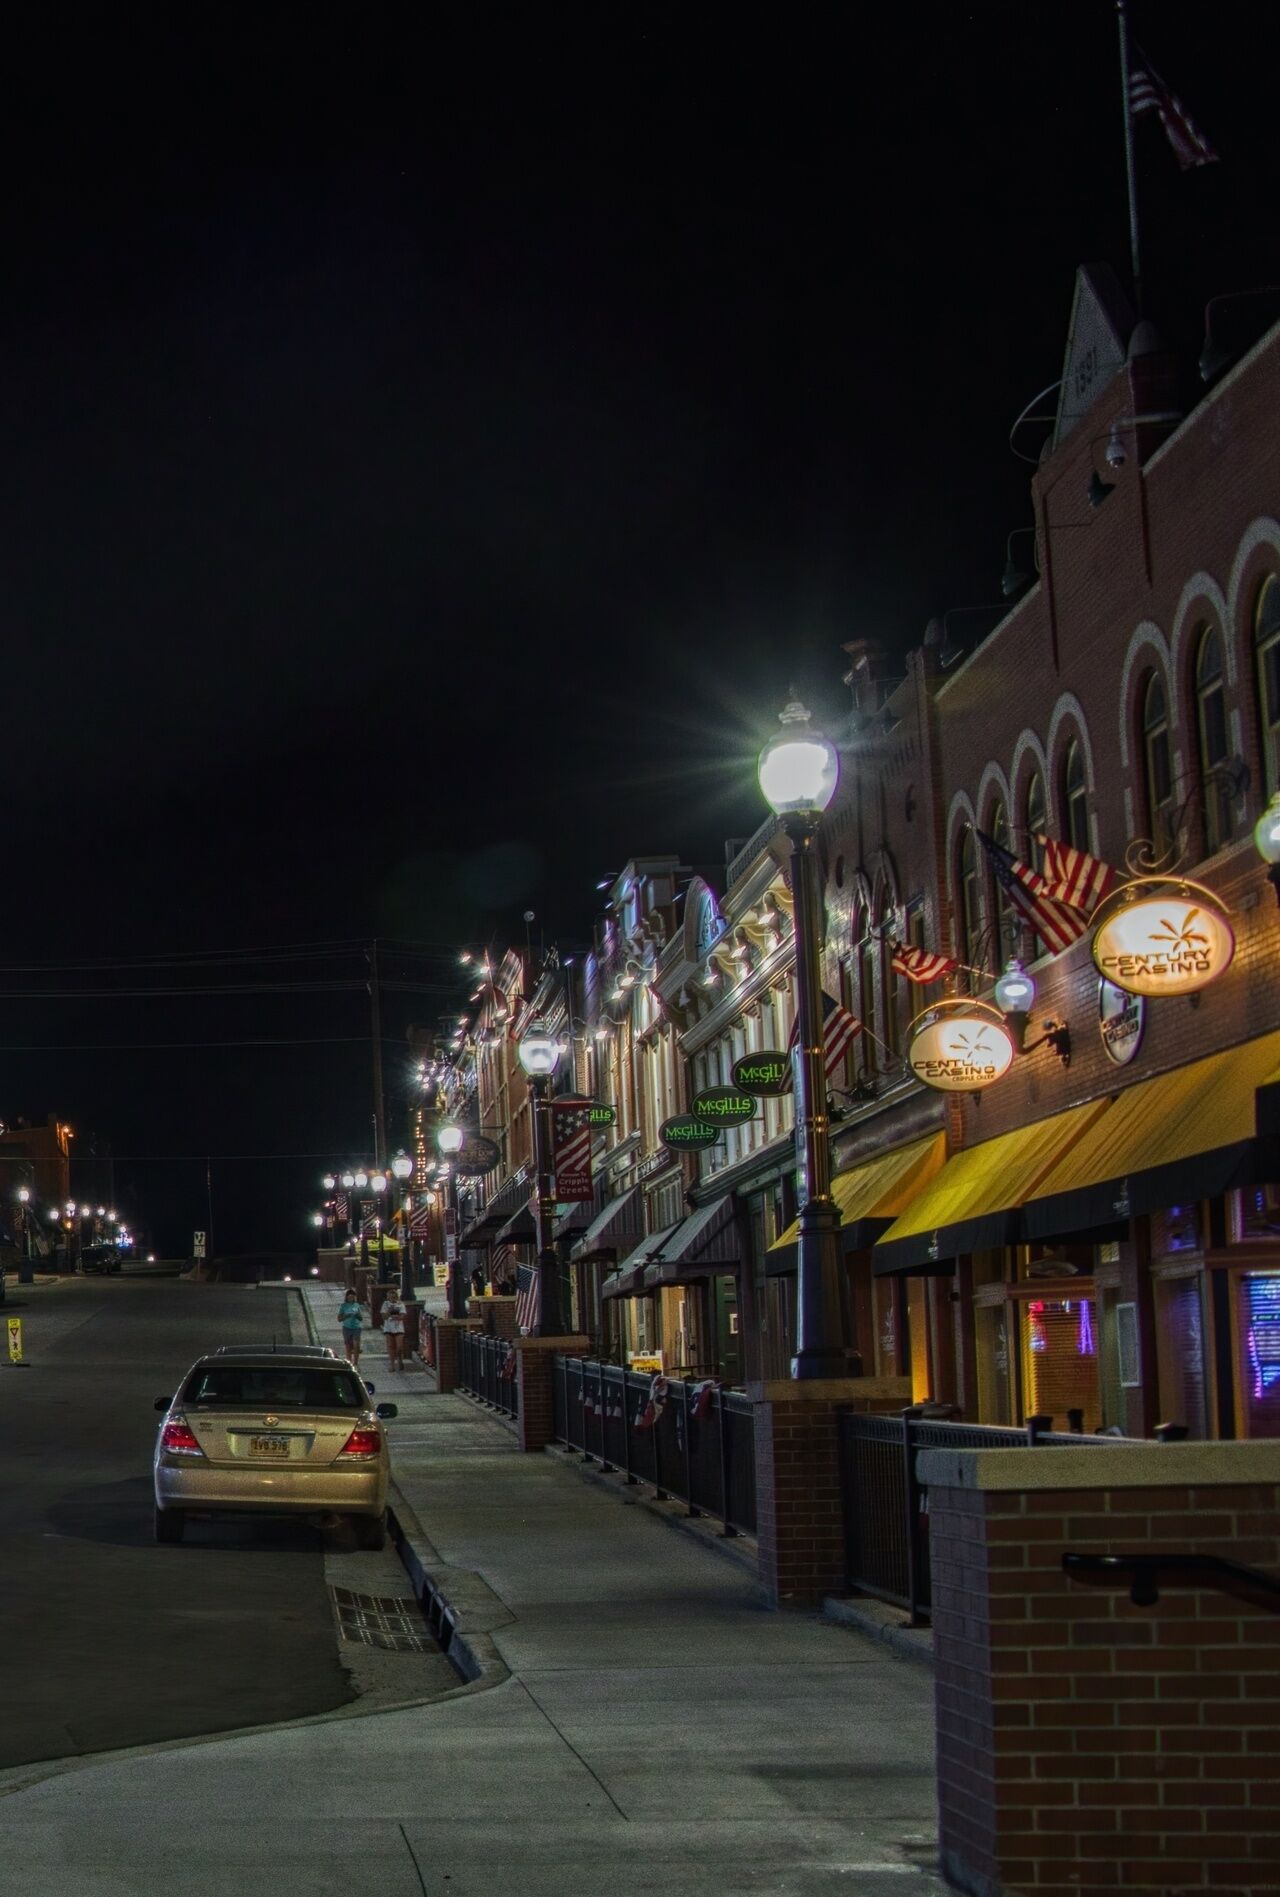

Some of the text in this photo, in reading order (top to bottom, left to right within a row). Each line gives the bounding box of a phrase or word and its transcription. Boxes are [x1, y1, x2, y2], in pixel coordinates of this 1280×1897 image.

[1102, 949, 1211, 967] CENTURY
[1119, 961, 1210, 977] CASINO
[914, 1060, 986, 1070] CENTU
[926, 1066, 995, 1078] CASINO
[559, 1177, 589, 1186] Cripple
[559, 1186, 590, 1195] Creek
